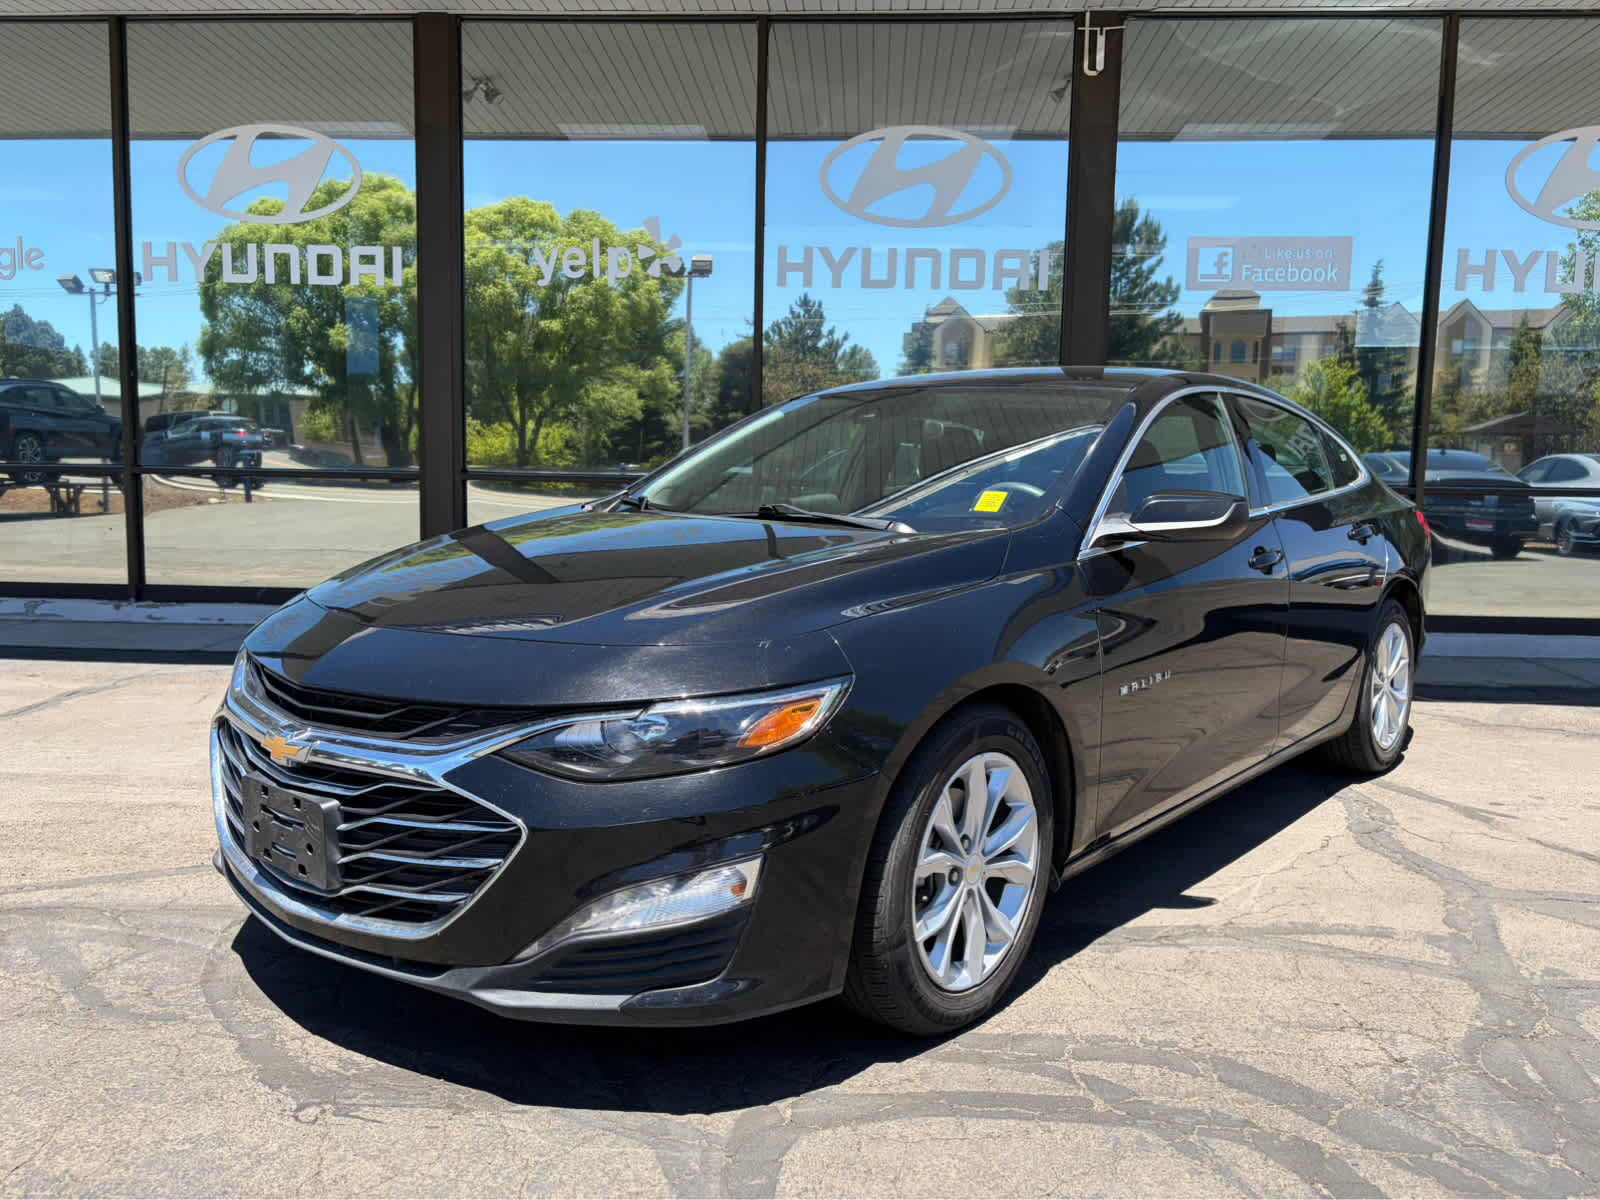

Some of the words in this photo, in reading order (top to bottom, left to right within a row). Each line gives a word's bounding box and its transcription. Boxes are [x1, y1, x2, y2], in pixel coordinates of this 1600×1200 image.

[141, 241, 403, 287] HYUNDAI
[533, 237, 633, 289] yelp
[776, 245, 1051, 291] HYUNDAI
[1241, 262, 1340, 283] Facebook
[1264, 247, 1293, 260] Like
[1297, 248, 1313, 260] us
[1315, 249, 1335, 259] on
[1455, 248, 1600, 293] HYU
